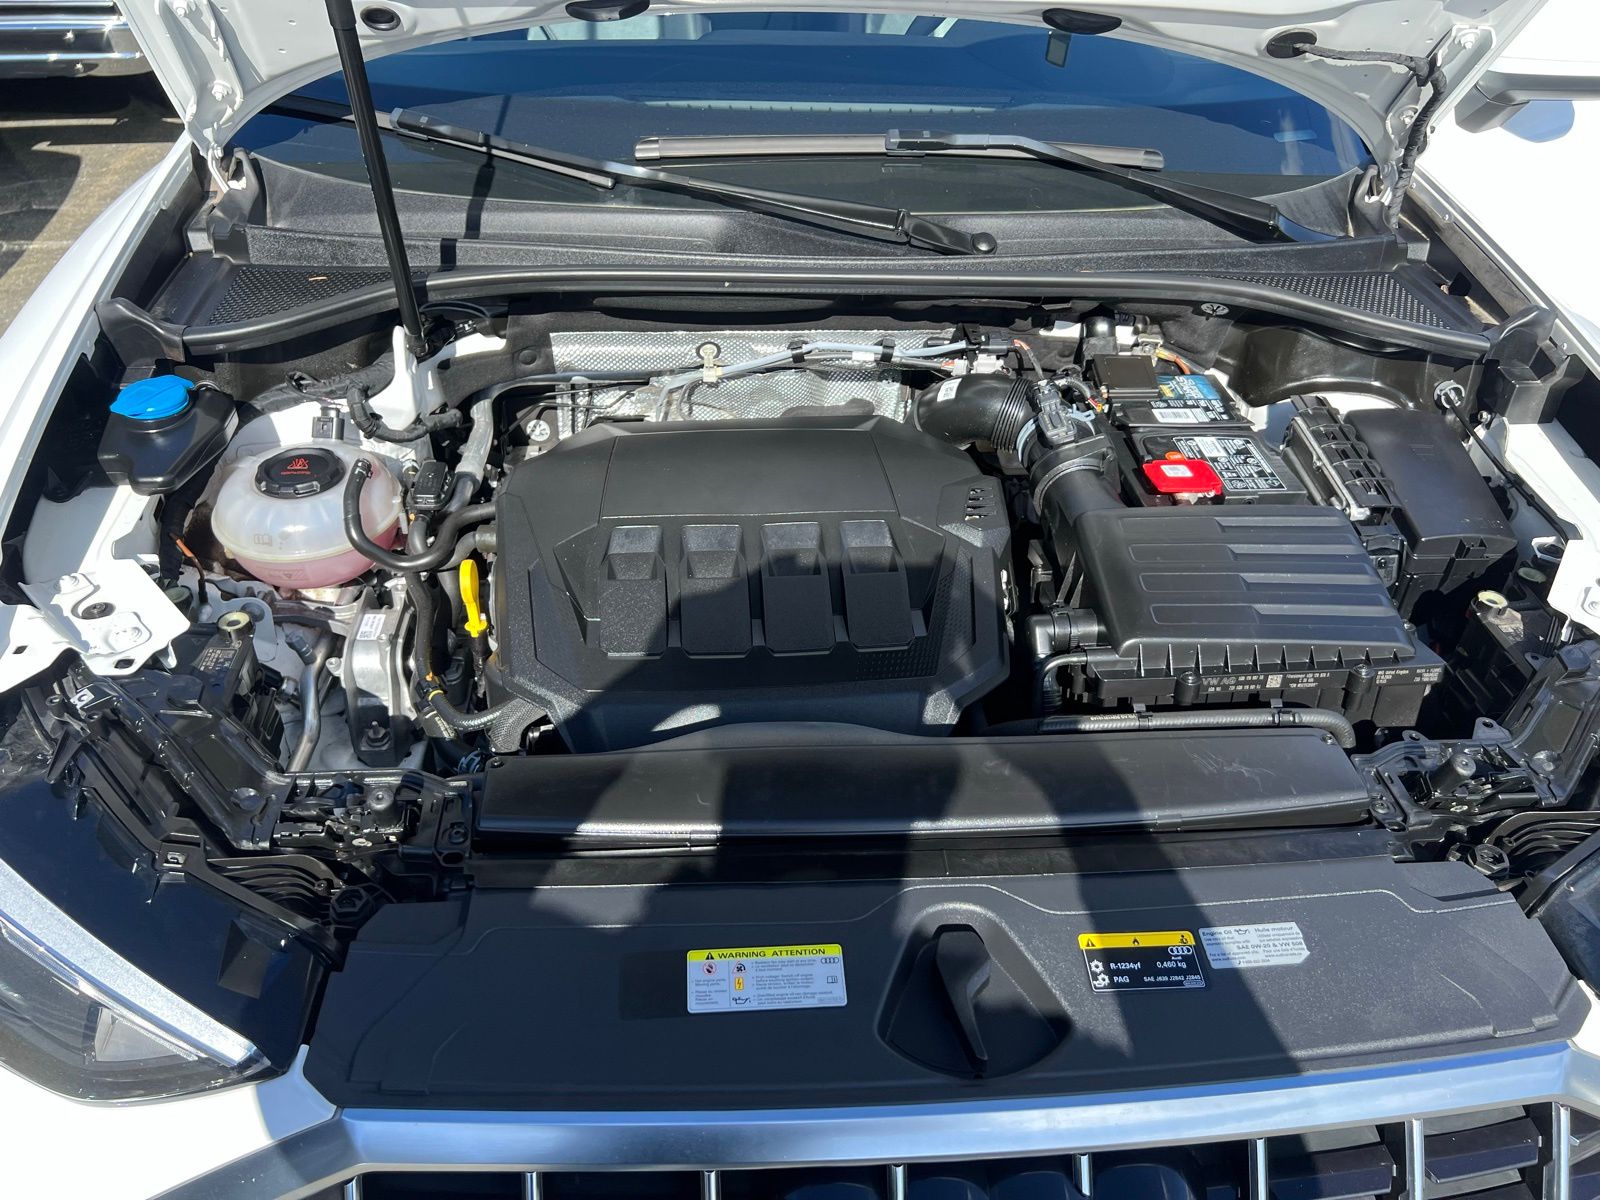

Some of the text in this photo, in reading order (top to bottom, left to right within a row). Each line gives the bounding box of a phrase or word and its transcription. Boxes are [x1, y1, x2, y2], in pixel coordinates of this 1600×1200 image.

[1220, 676, 1236, 685] AG
[718, 948, 826, 959] WARNING ATTENTION
[1110, 962, 1141, 970] R-1234yf
